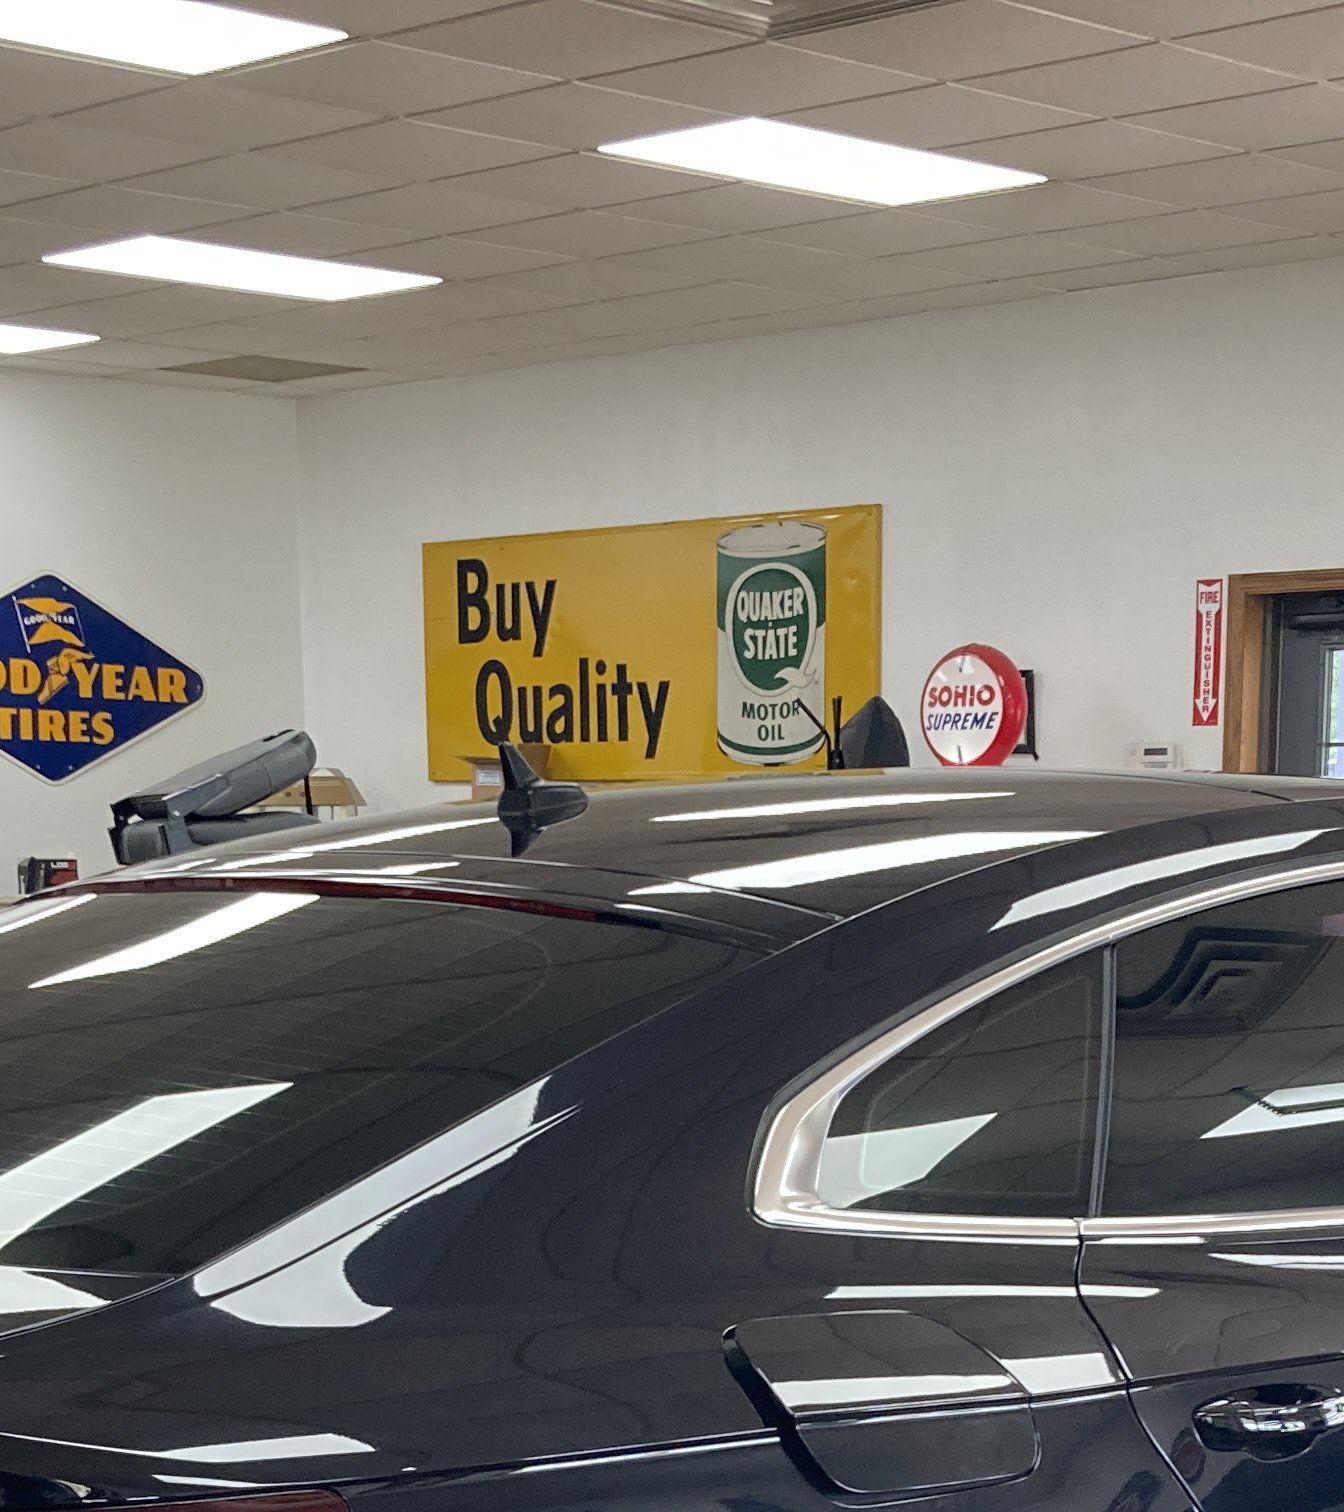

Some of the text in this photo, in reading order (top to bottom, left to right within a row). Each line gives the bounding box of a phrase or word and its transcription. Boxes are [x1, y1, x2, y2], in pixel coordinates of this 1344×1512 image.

[457, 557, 558, 658] Buy
[736, 586, 805, 624] QUAKER
[1199, 590, 1220, 605] FIRE
[743, 624, 798, 661] STATE
[1201, 610, 1214, 713] EXTINGUISHER
[475, 657, 671, 760] Quality
[741, 700, 801, 722] MOTOR
[927, 684, 996, 709] SOHIO
[757, 723, 785, 742] OIL
[925, 711, 1000, 731] SUPREME
